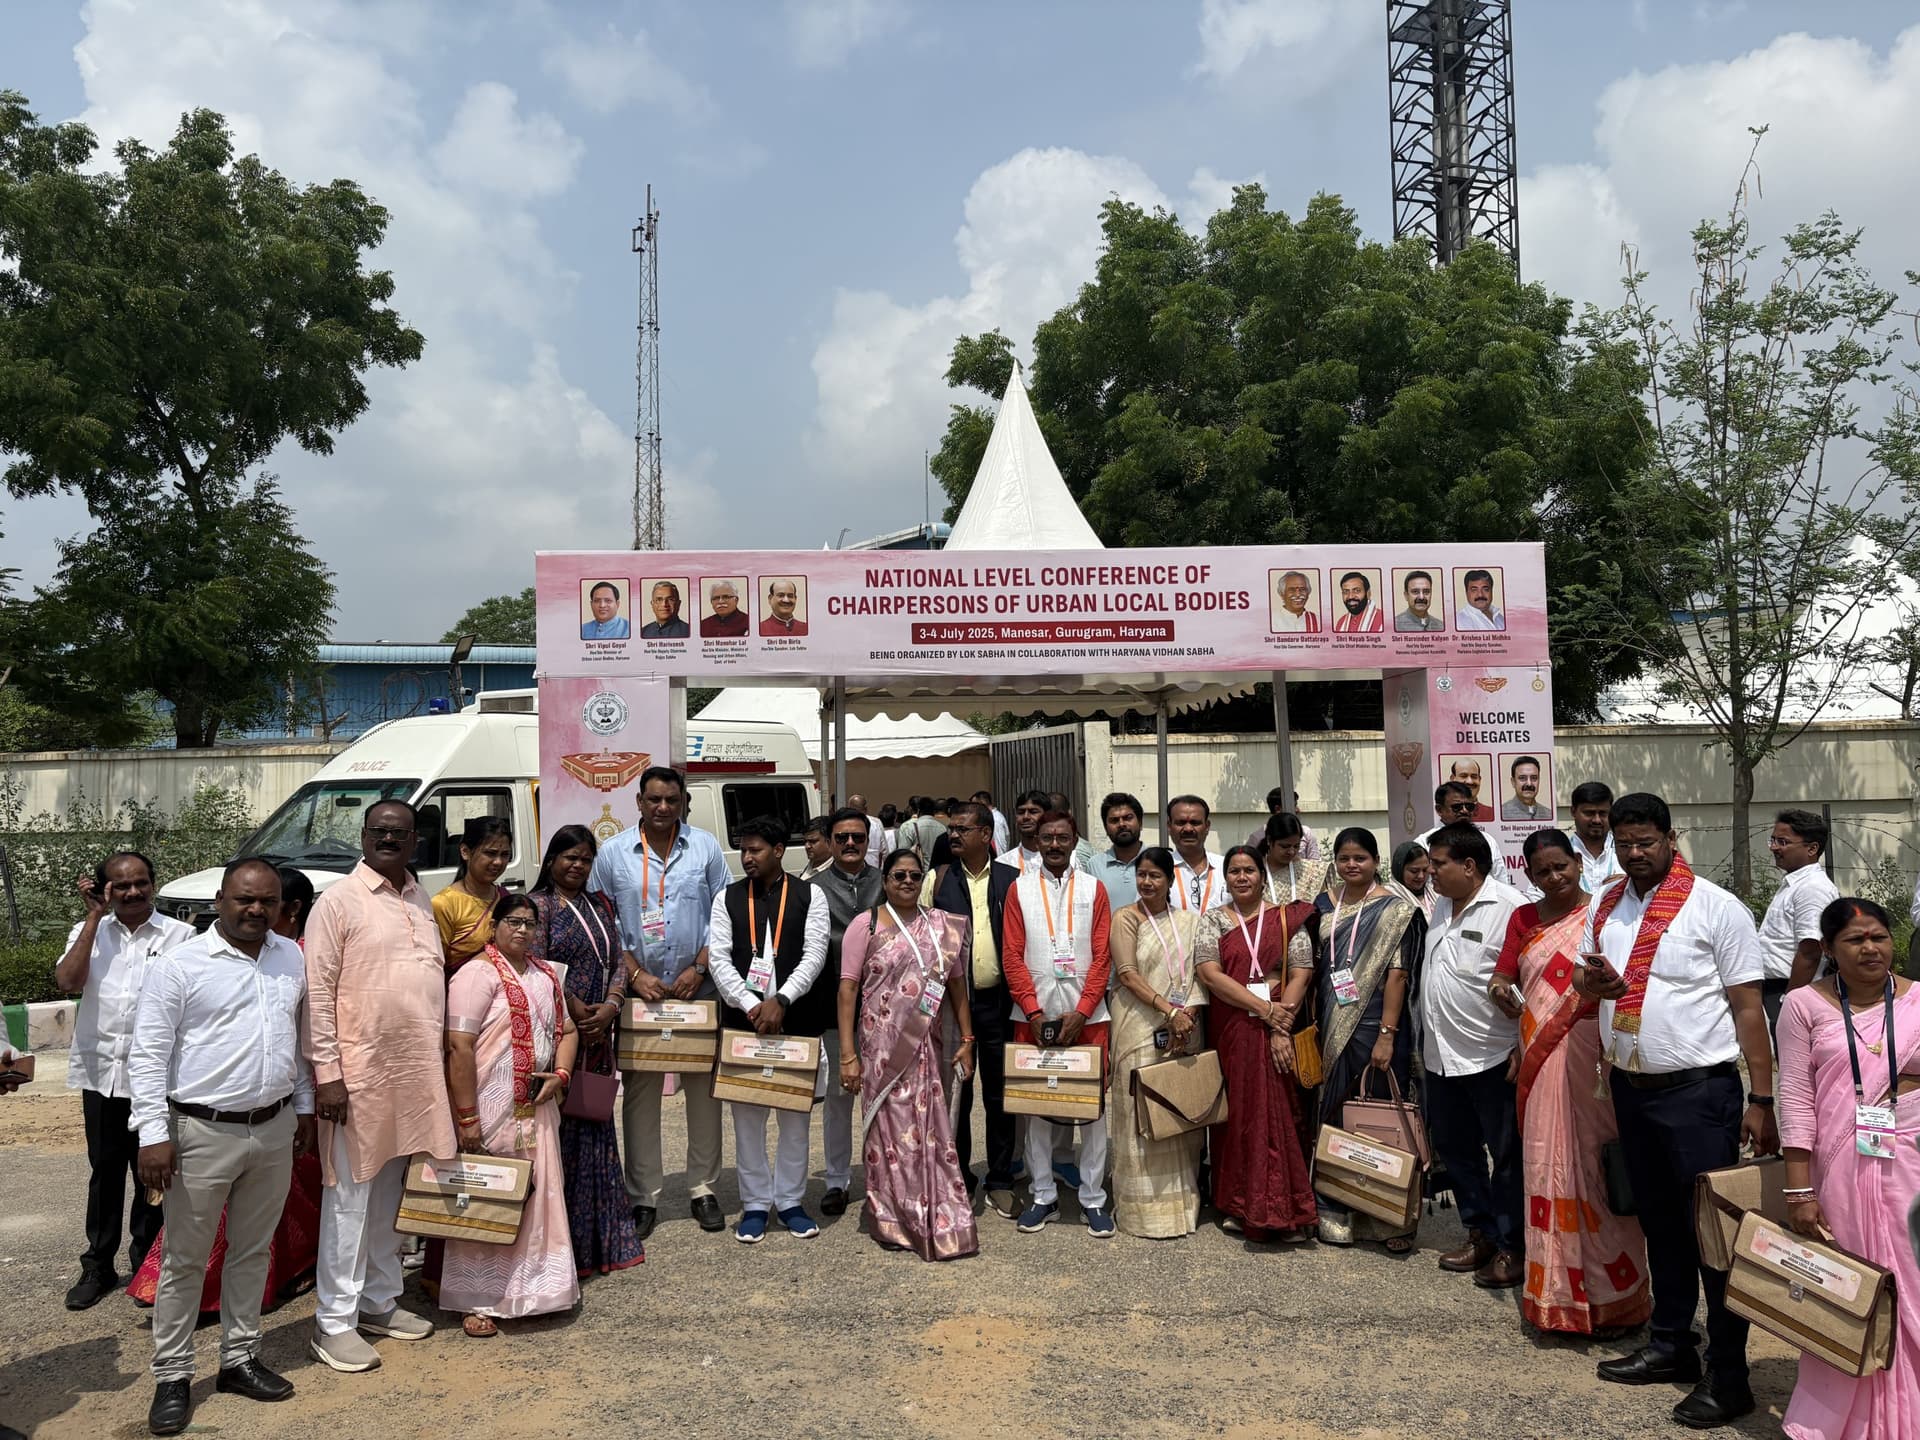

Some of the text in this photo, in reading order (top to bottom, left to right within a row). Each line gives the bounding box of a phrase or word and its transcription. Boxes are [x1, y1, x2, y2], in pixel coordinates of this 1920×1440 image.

[865, 565, 1211, 588] NATIONAL LEVEL CONFERENCE OF
[827, 591, 1250, 616] CHAIRPERSONS OF URBAN LOCAL BODIES
[919, 626, 1166, 641] 3-4 July 2025, Manesar, Gurugram, Haryana
[870, 647, 1215, 660] BEING ORGANIZED BY LOK SABHA IN COLLABORATION WITH HARYANA VIDHAN SABHA
[1459, 711, 1525, 725] WELCOME
[1456, 730, 1531, 744] DELEGATES
[346, 760, 391, 773] POLICE
